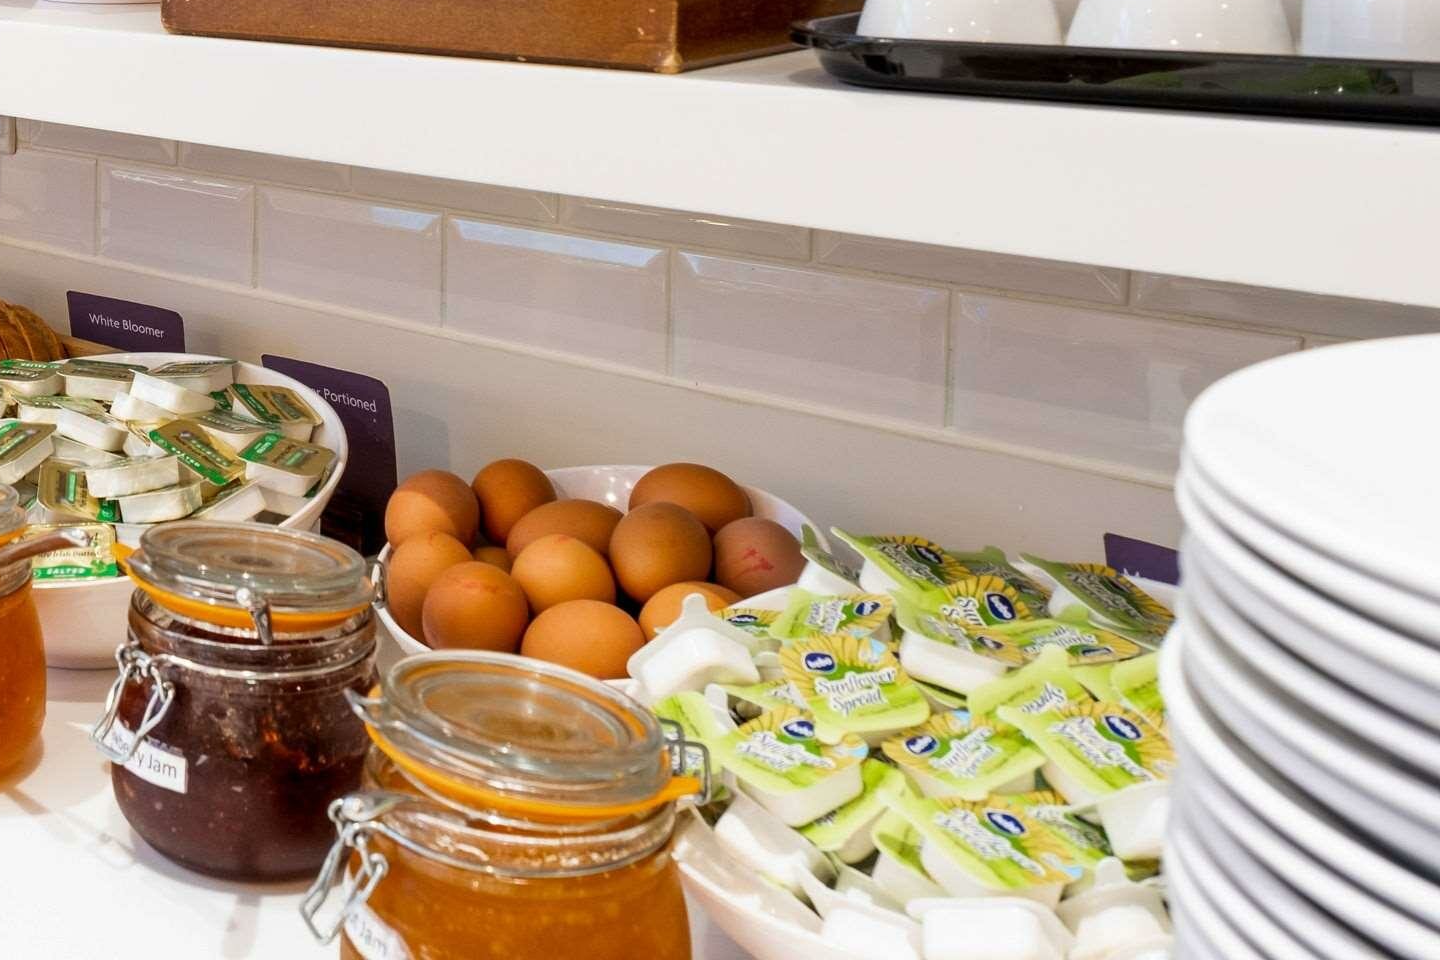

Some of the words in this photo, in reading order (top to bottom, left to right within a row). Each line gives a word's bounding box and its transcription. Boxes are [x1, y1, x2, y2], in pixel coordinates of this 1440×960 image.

[89, 313, 120, 329] White
[123, 319, 165, 338] Bloomer
[324, 387, 377, 413] Portioned
[818, 669, 896, 694] Sunflower
[833, 689, 884, 716] Spread
[147, 753, 177, 779] Jam
